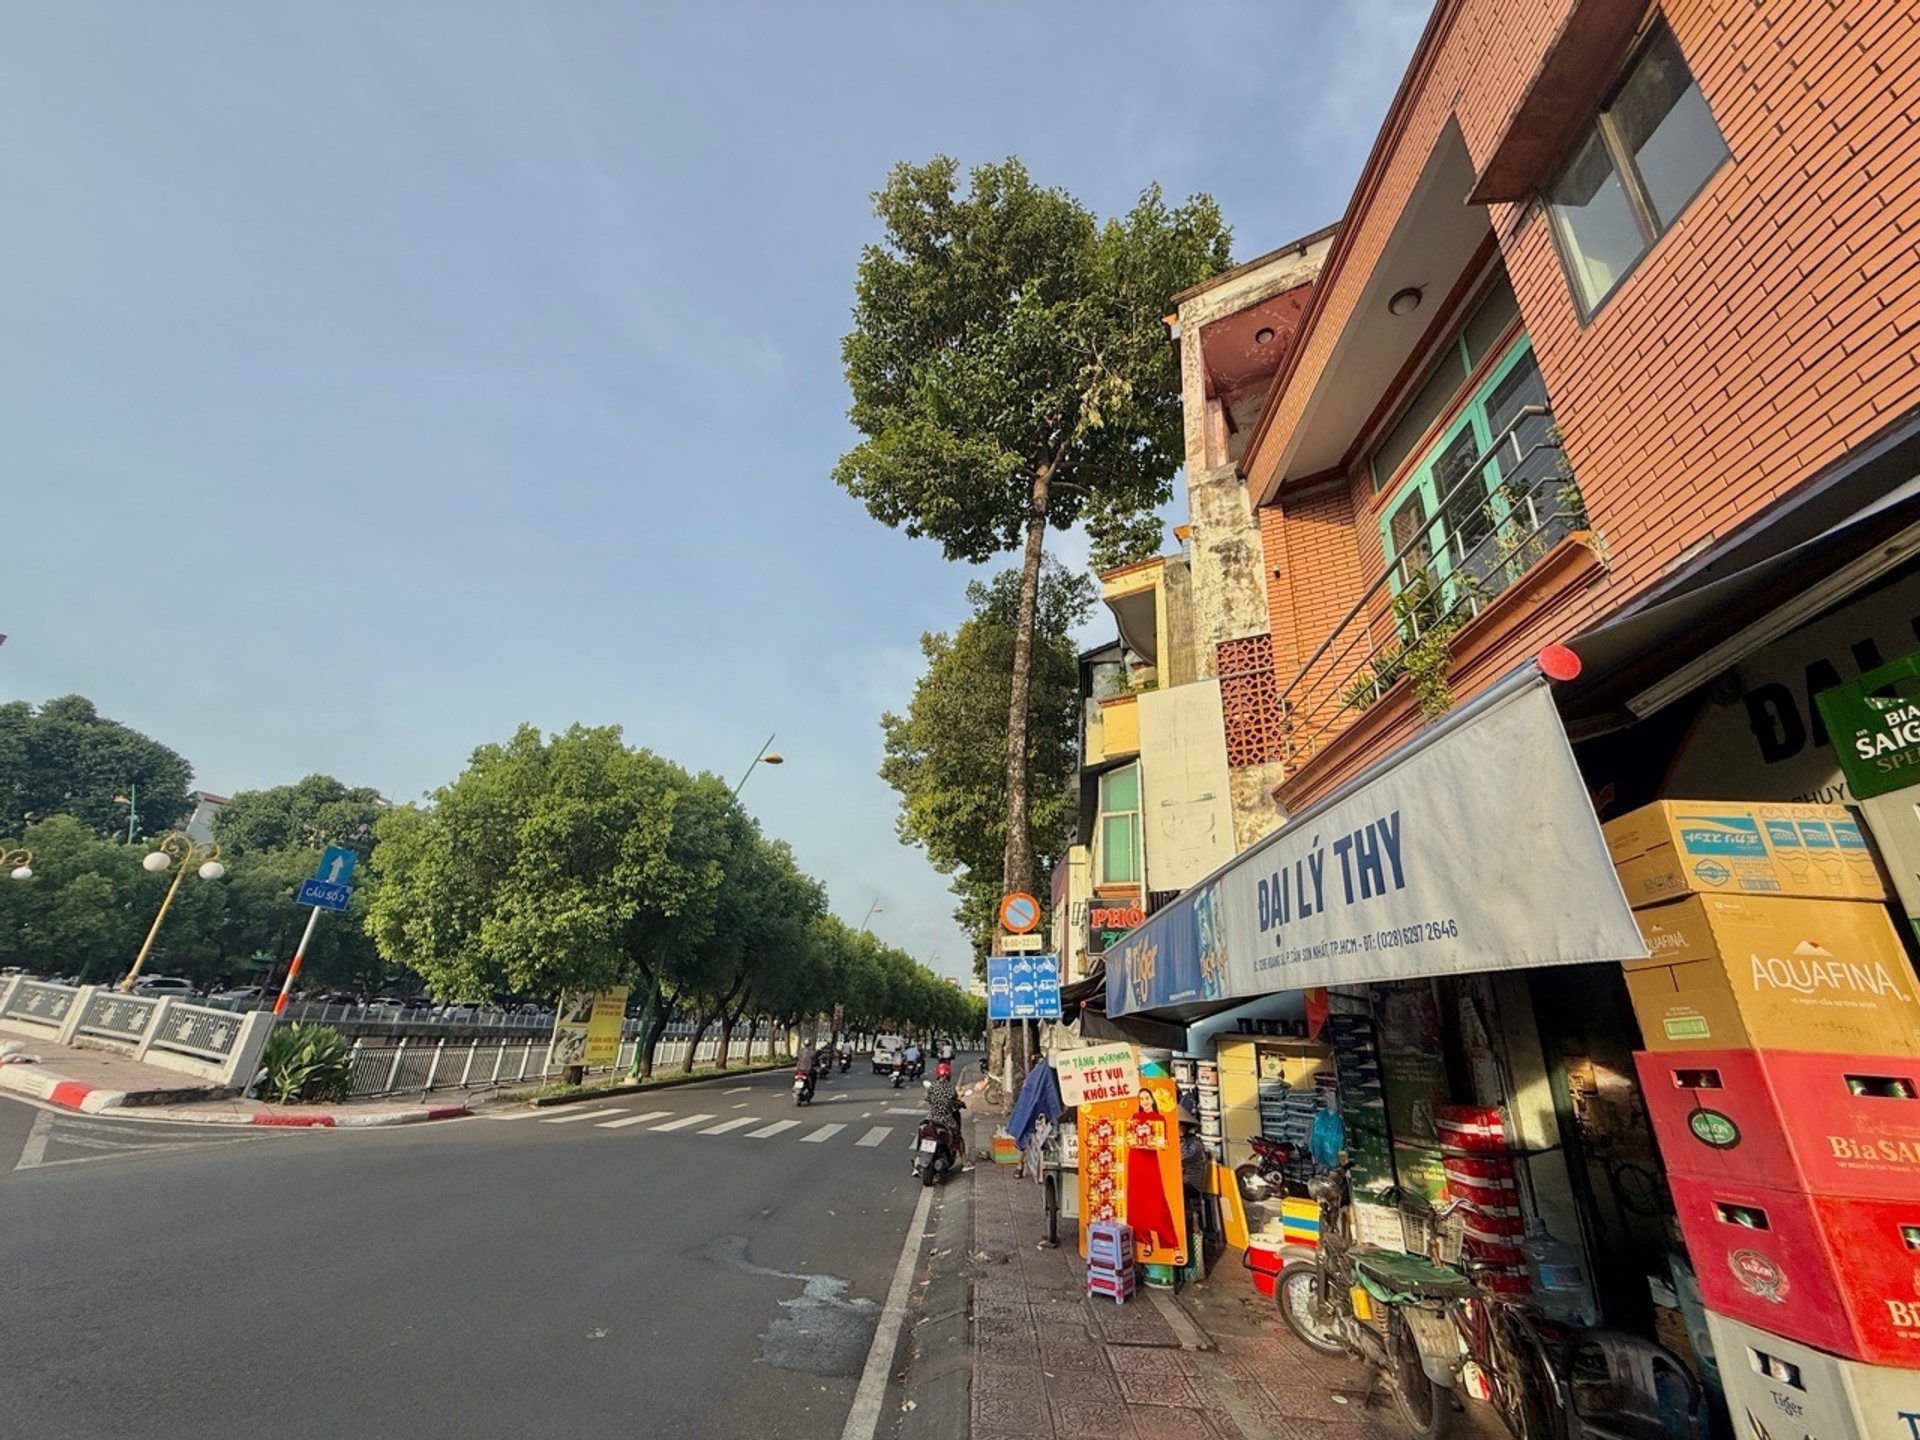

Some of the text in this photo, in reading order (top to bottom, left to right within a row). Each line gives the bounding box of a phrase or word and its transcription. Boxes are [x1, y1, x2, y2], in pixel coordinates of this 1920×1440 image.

[1258, 809, 1406, 948] ĐẠI LÝ THY
[1091, 899, 1147, 928] PHỞ
[1425, 919, 1458, 941] 2646
[1751, 953, 1906, 1002] AQUAFINA
[1072, 1056, 1095, 1071] TẶNG
[1083, 1067, 1103, 1084] TẾT
[1106, 1067, 1124, 1080] VUI
[1083, 1080, 1131, 1101] KHỞI SẮC
[1829, 1136, 1879, 1161] Bia
[1771, 1390, 1803, 1416] Tiger
